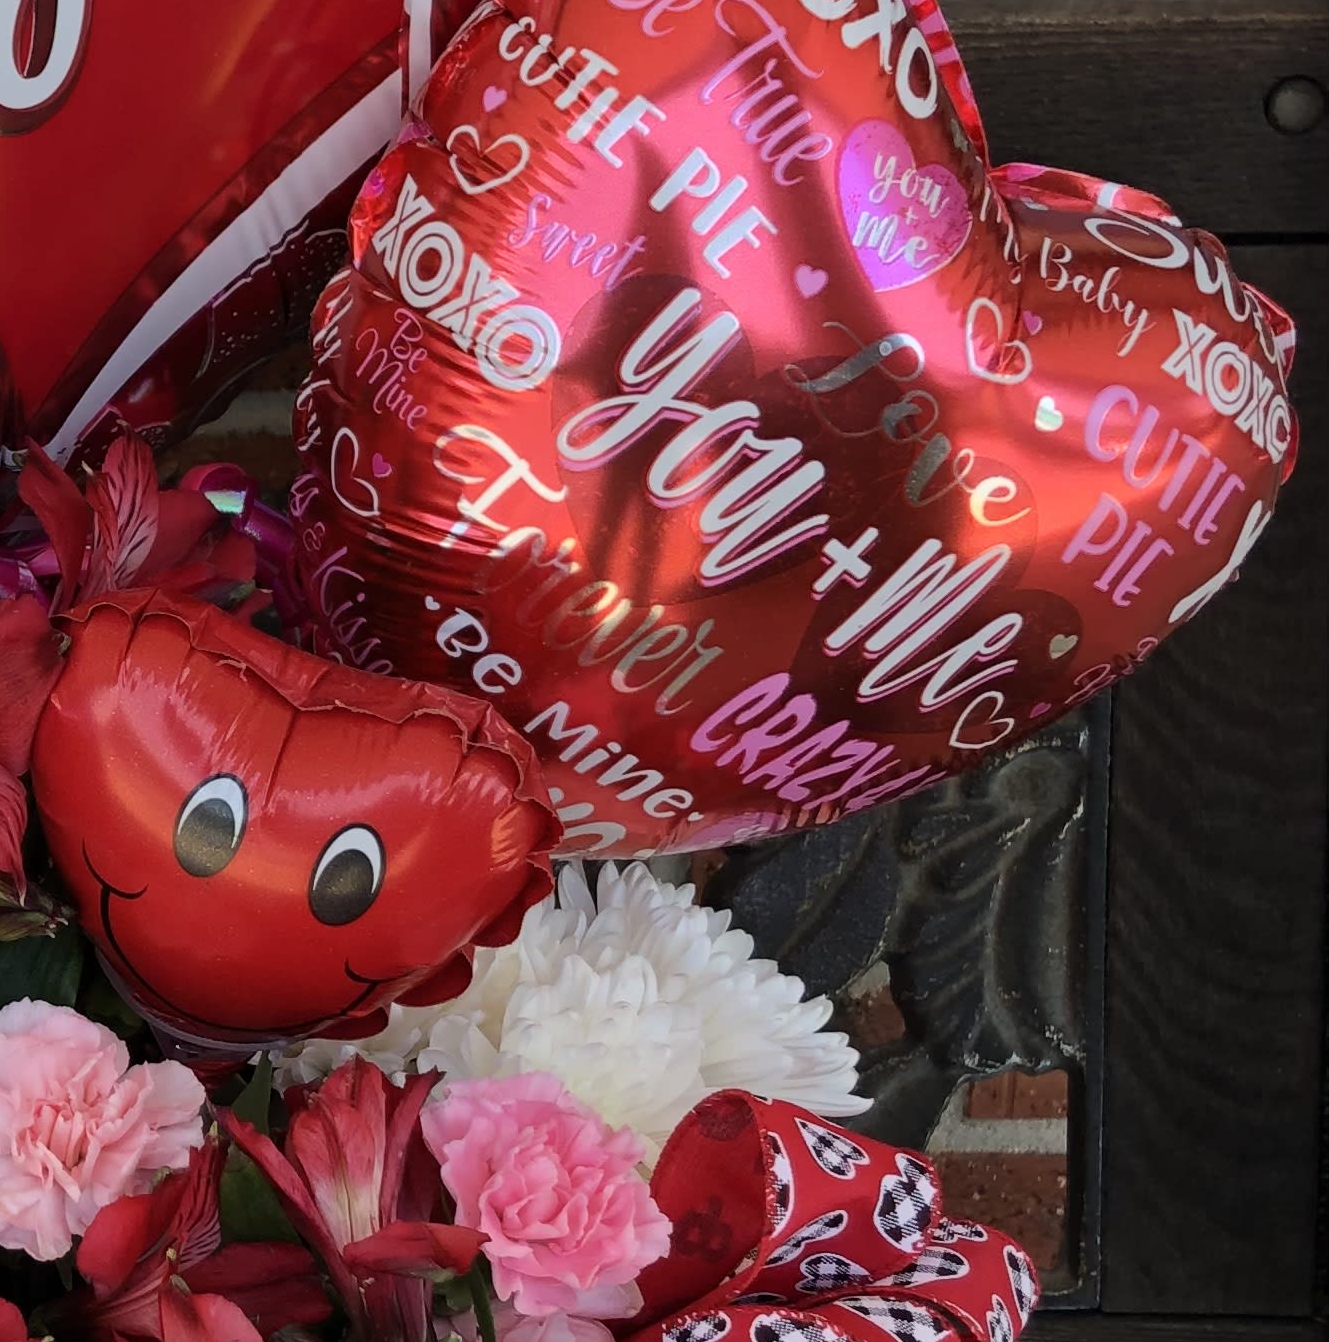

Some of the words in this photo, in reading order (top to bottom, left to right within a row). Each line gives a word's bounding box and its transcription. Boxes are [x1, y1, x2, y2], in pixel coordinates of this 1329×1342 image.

[498, 15, 668, 170] CUTIE
[648, 146, 778, 280] PIE
[372, 172, 563, 392] XOXO
[508, 192, 649, 290] Sweet
[1039, 236, 1157, 358] Baby
[355, 327, 429, 432] Mine
[389, 307, 429, 375] Be
[782, 321, 1031, 528] Love
[1084, 384, 1245, 546] CUTIE
[433, 424, 725, 716] Forever
[810, 526, 879, 601] +
[1061, 492, 1174, 608] PIE
[434, 605, 524, 695] Be
[523, 700, 694, 820] Mine
[689, 671, 902, 810] CRAZY
